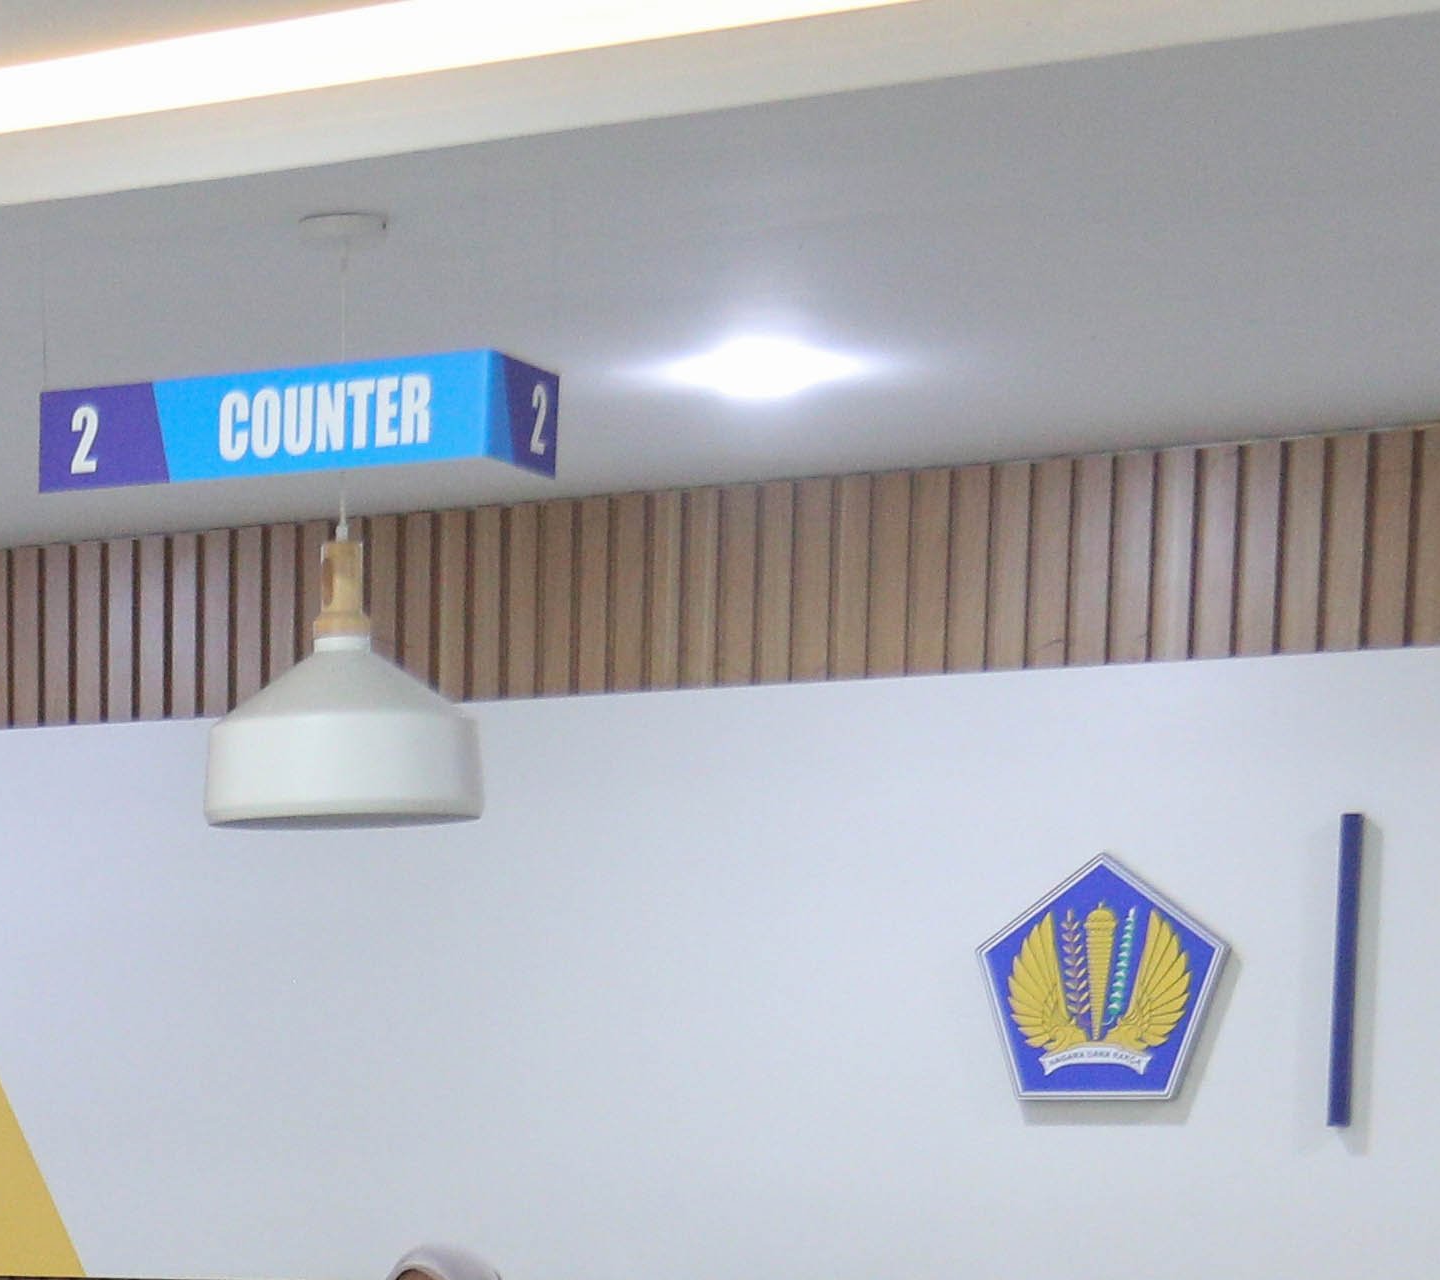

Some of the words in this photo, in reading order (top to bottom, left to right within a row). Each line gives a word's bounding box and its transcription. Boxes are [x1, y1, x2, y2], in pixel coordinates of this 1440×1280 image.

[70, 405, 100, 475] 2
[218, 373, 432, 462] COUNTER
[530, 383, 549, 456] 2
